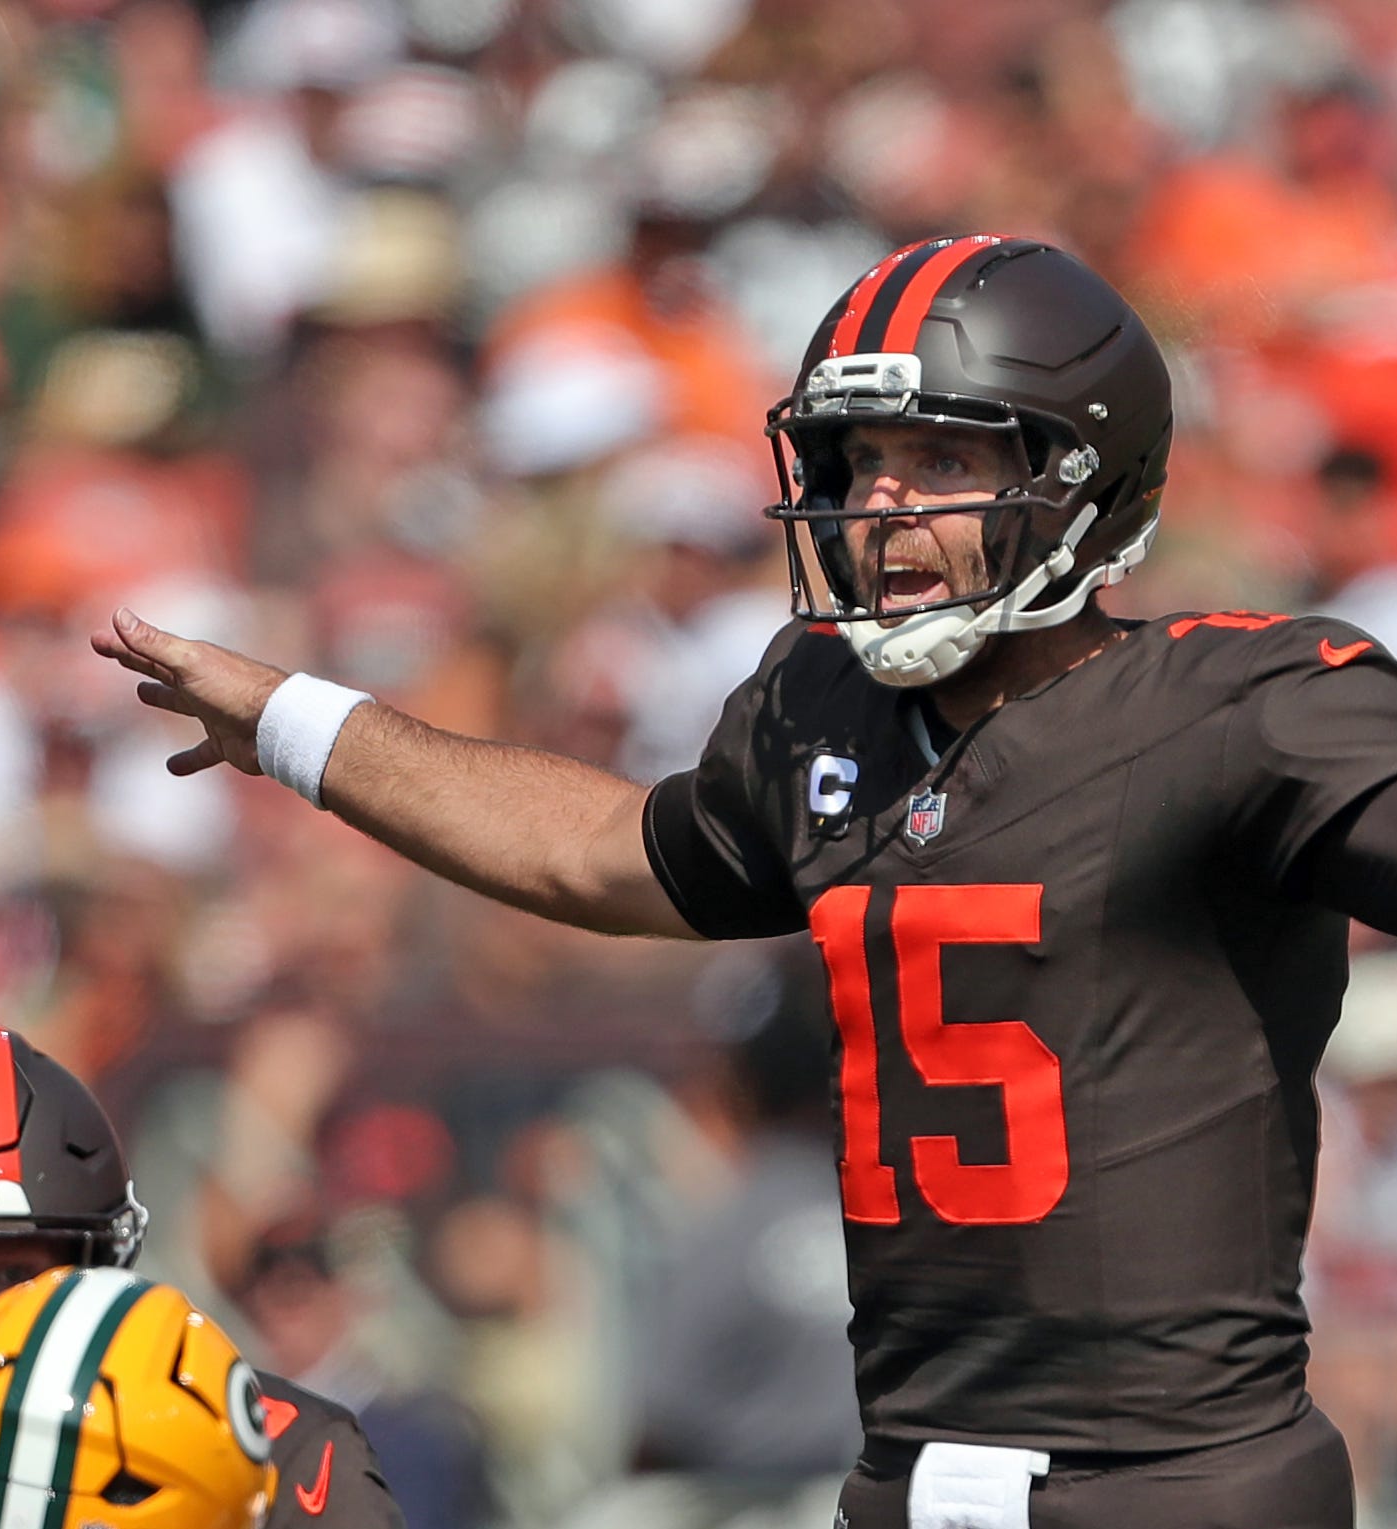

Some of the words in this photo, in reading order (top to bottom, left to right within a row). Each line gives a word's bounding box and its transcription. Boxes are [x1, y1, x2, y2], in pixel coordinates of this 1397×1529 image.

[809, 755, 859, 816] C
[912, 812, 938, 834] NFL
[808, 882, 1070, 1226] 15
